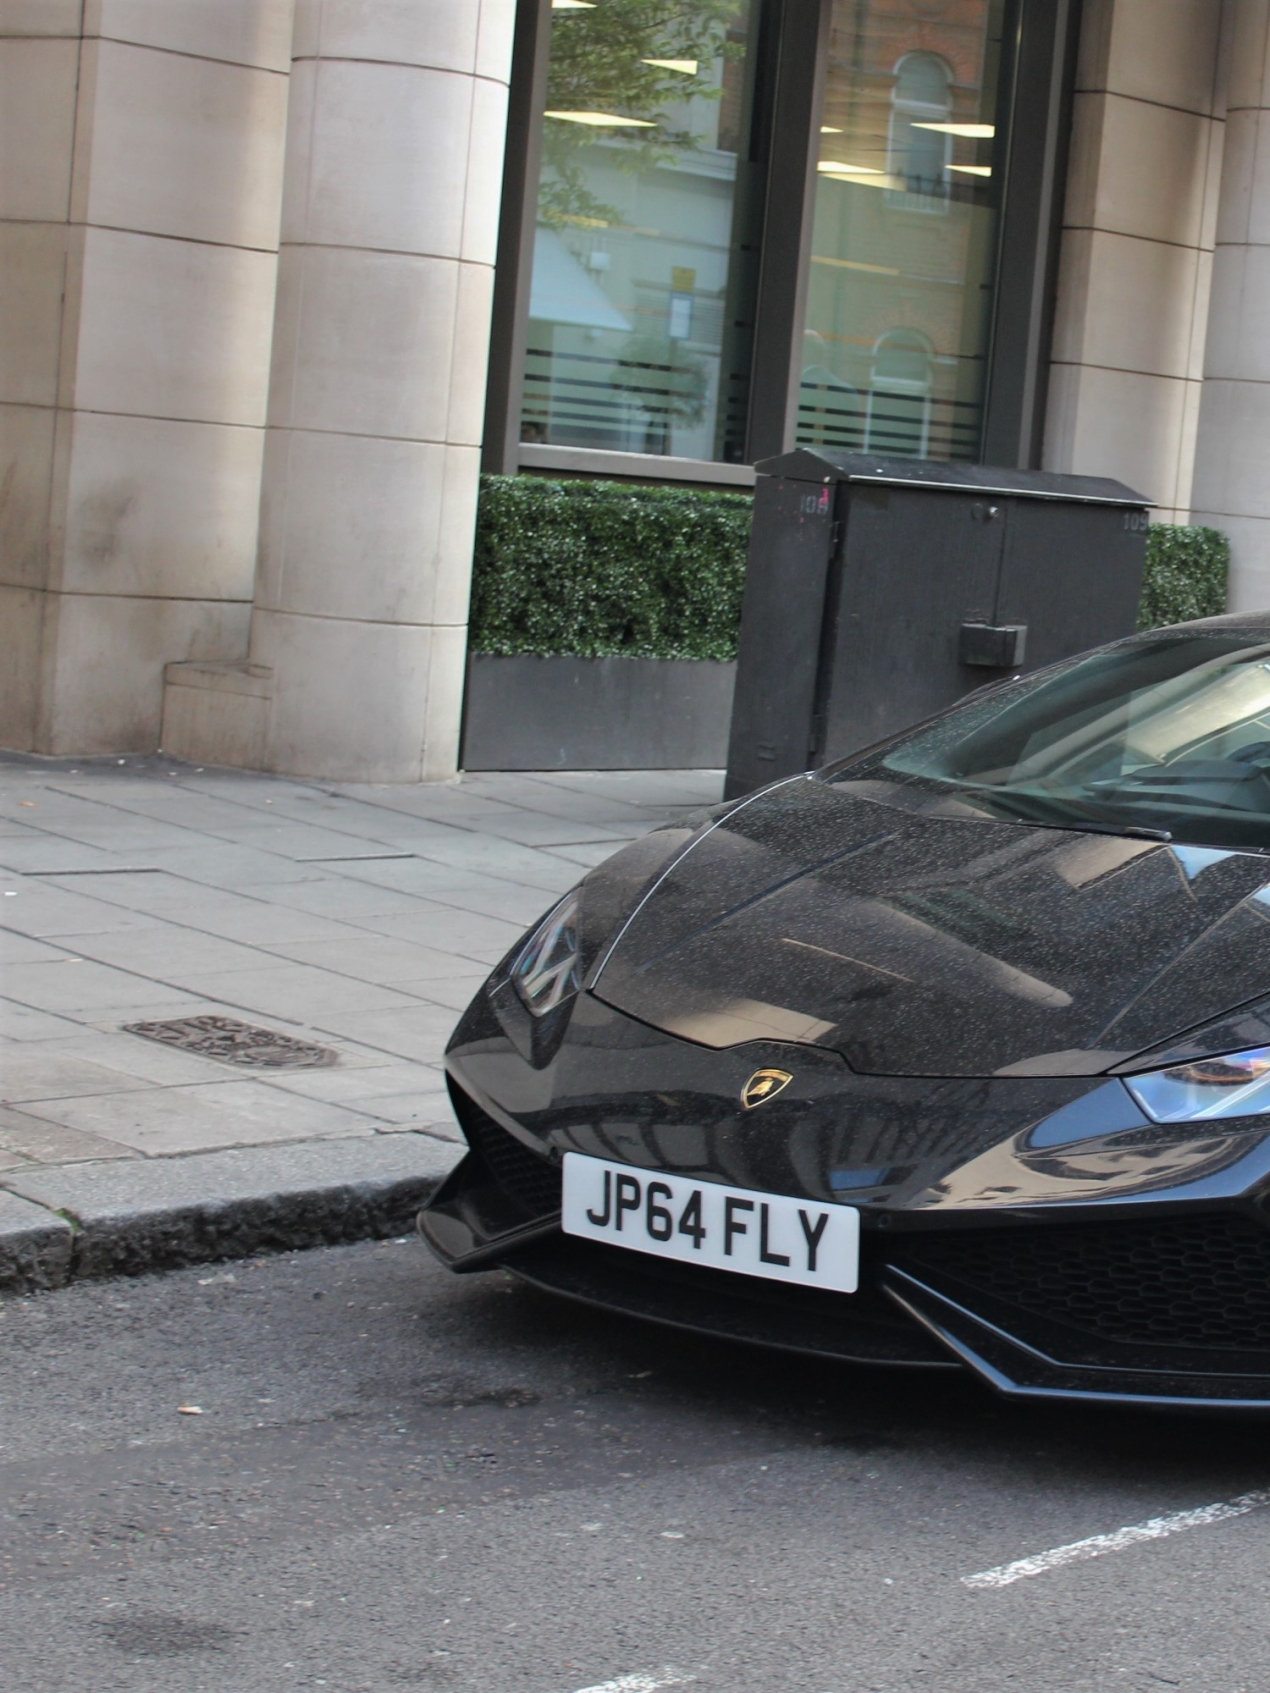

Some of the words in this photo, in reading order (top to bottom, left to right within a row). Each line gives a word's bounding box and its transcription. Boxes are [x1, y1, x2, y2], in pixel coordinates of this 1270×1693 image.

[1124, 512, 1149, 531] 109
[586, 1170, 706, 1250] JP64
[724, 1196, 829, 1272] FLY
